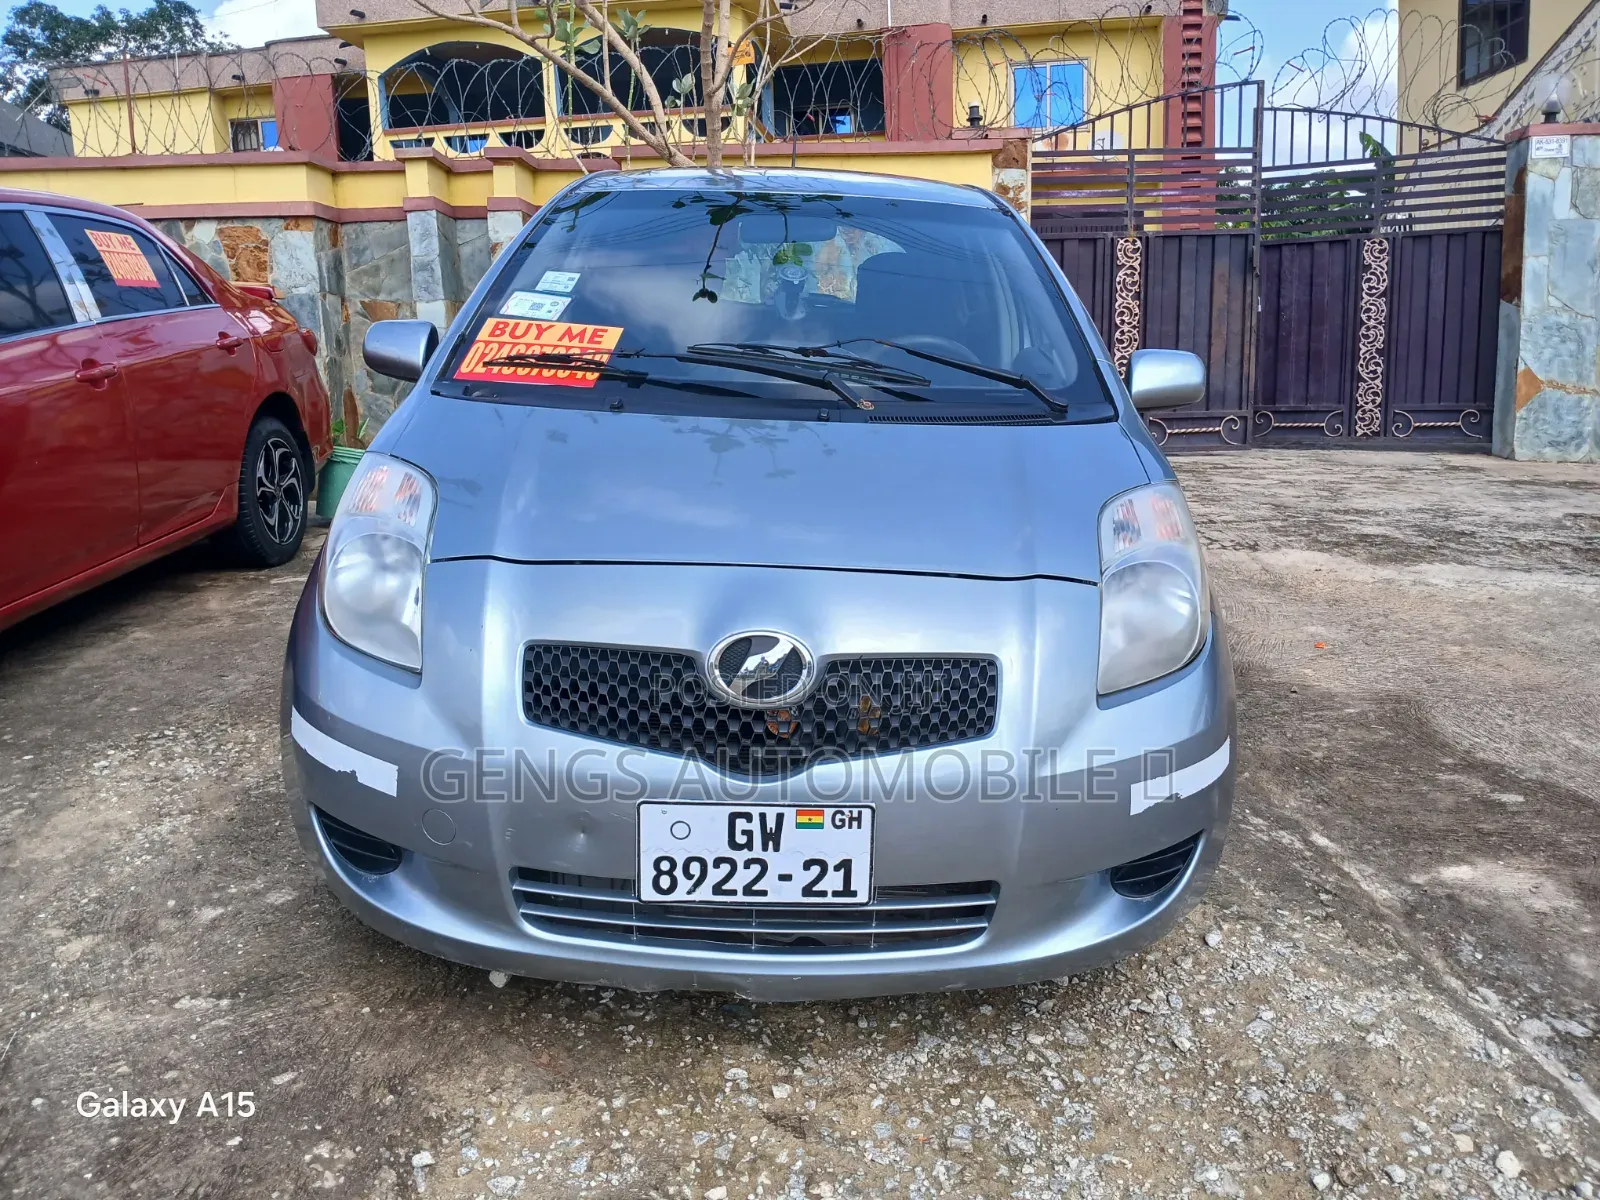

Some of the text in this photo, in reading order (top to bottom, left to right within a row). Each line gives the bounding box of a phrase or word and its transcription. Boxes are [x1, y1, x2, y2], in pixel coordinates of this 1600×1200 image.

[89, 231, 136, 251] BUY ME
[488, 321, 609, 345] BUY ME
[727, 811, 785, 852] GW
[831, 809, 863, 830] GH
[651, 855, 858, 898] 8922-21
